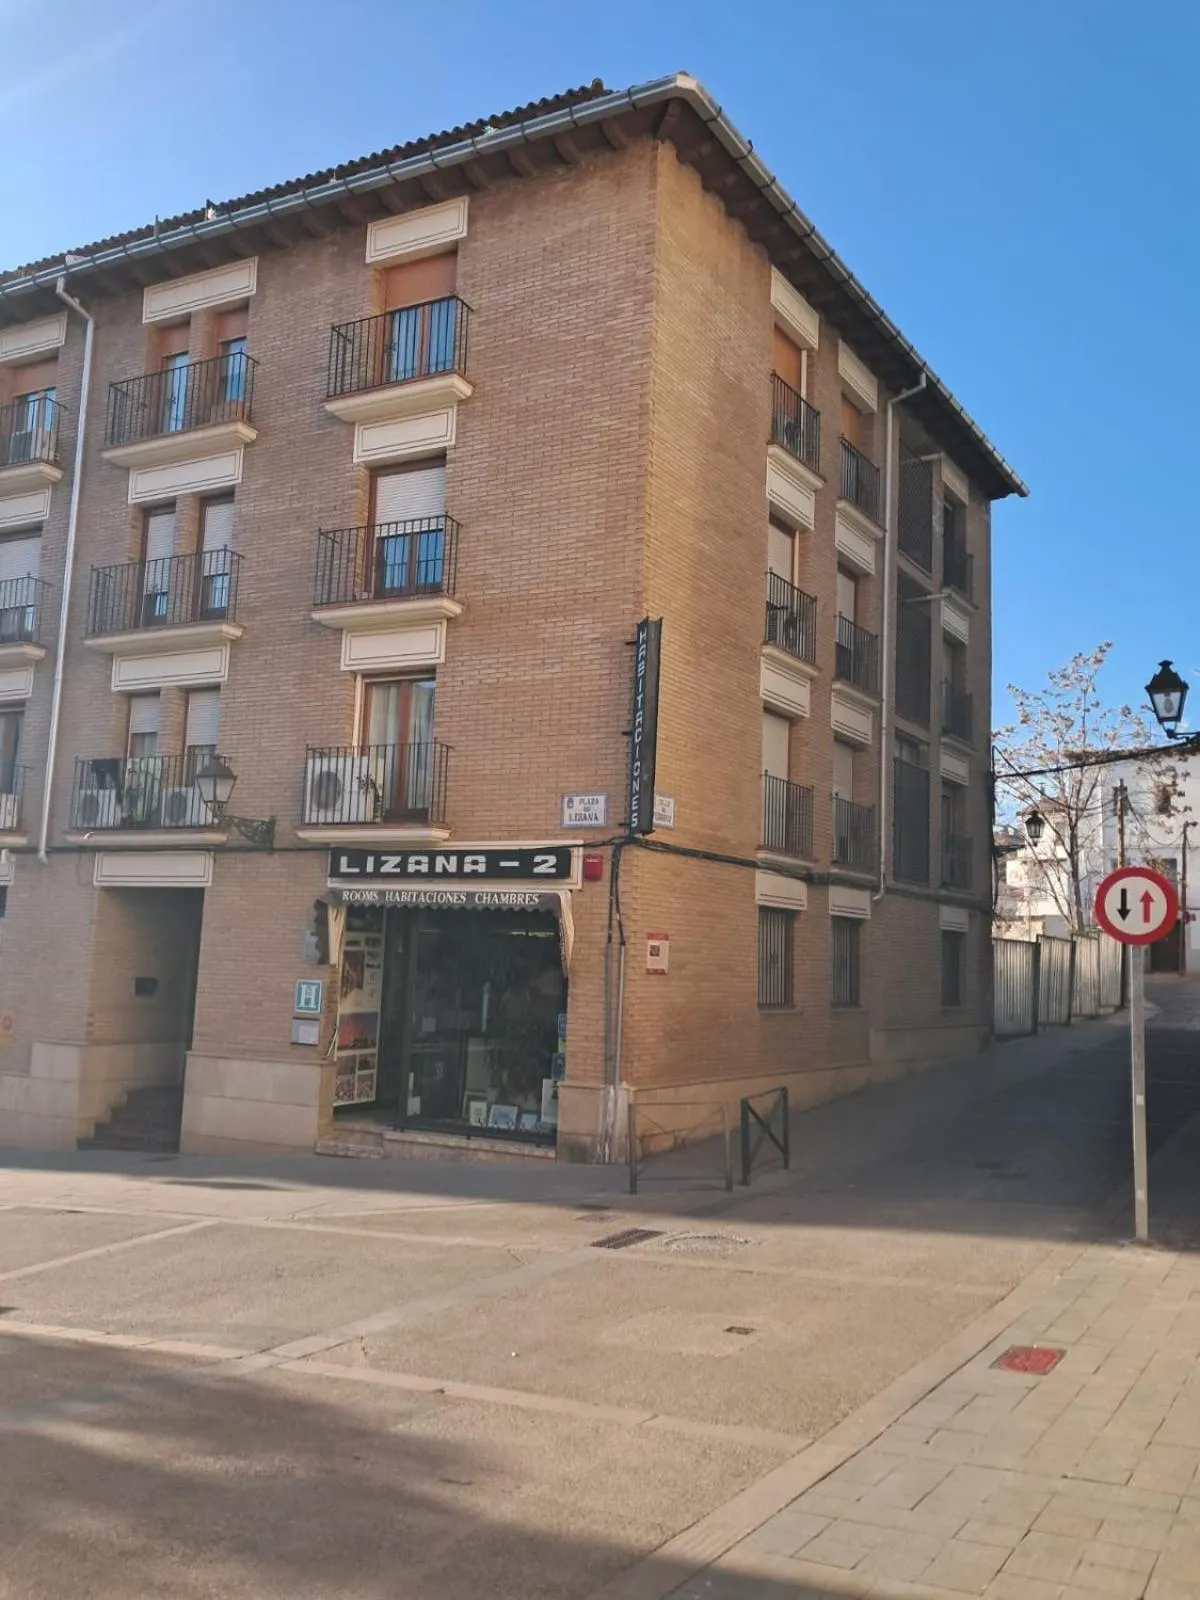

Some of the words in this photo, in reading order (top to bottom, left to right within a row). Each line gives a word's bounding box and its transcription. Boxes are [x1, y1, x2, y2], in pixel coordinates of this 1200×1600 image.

[631, 627, 648, 828] HABITACIONES
[340, 855, 487, 873] LIZANA
[533, 855, 557, 873] 2
[342, 890, 379, 901] ROOMS
[385, 891, 467, 904] HABITACIONES
[474, 893, 541, 905] CHAMBRES
